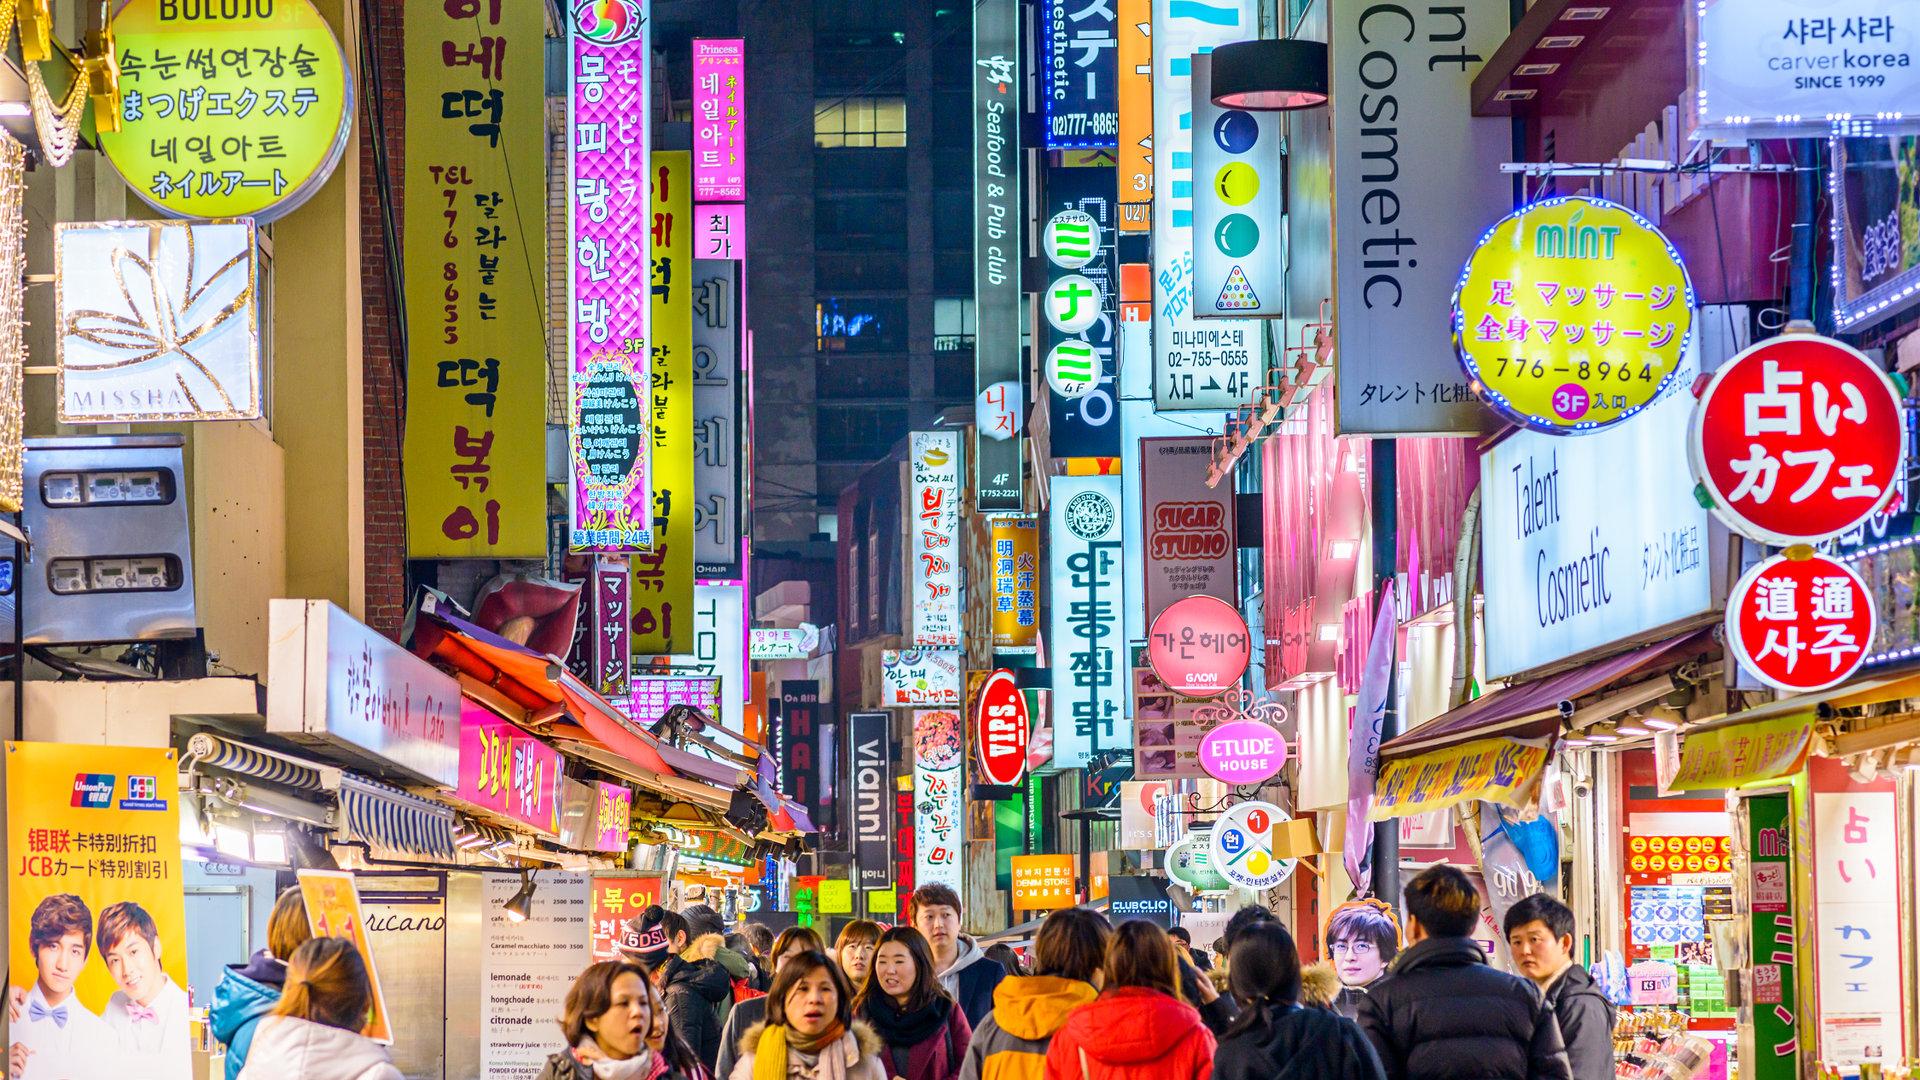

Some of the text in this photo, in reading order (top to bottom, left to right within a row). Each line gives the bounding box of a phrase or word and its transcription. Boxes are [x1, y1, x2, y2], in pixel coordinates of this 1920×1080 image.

[1783, 16, 1894, 45] 샤라 샤라
[120, 43, 320, 80] 속눈썹연장술
[700, 45, 738, 54] Princess
[1768, 49, 1910, 71] carver korea
[1795, 75, 1885, 89] SINCE 1999
[123, 87, 319, 121] まつげエクステ
[701, 73, 722, 167] 네일아트
[726, 76, 738, 165] ネイルアート
[150, 135, 287, 163] 네일아트
[987, 100, 1006, 178] Seafood
[1358, 4, 1417, 310] Cosmetic
[150, 170, 288, 198] ネイルアート
[429, 165, 473, 185] TEL
[577, 58, 612, 343] 몽피랑한방
[699, 188, 740, 196] 777-8562
[988, 184, 1005, 197] &
[988, 204, 1006, 239] Pub
[474, 191, 506, 320] 달라붙는
[988, 246, 1007, 285] club
[1489, 281, 1677, 310] 足 マッサージ
[1172, 331, 1244, 347] 미나미에스테
[1476, 314, 1676, 347] 全身マッサージ
[624, 338, 644, 354] 3F
[1168, 351, 1248, 368] 02-755-0555
[1497, 357, 1652, 383] 776-8964
[72, 388, 182, 411] MISSHA
[1065, 383, 1085, 393] 4F
[1169, 372, 1249, 400] 入口 4F
[1744, 360, 1868, 437] 占い
[986, 386, 1015, 440] 니지
[1555, 392, 1587, 412] 3F
[1592, 394, 1627, 409] 入口
[437, 358, 500, 545] 떡볶이
[992, 474, 1009, 485] 4F
[1729, 443, 1881, 504] カフェ
[987, 489, 1019, 497] 752-2221
[1513, 446, 1600, 540] Talent
[1158, 506, 1221, 528] SUGAR
[921, 486, 951, 600] 부대찌개
[1153, 533, 1224, 556] STUDIO
[997, 540, 1014, 613] 明洞瑞草
[1537, 526, 1612, 628] Cosmetic
[603, 577, 624, 683] マッサージ
[1066, 551, 1118, 737] 안동찜닭
[1154, 626, 1246, 660] 가온헤어
[1755, 624, 1860, 675] 사주
[1185, 672, 1217, 682] GAON
[424, 695, 445, 744] Cafe
[988, 705, 1017, 757] VIPS
[1211, 738, 1274, 757] ETUDE
[1219, 760, 1268, 771] HOUSE
[74, 780, 113, 793] UnionPay
[857, 739, 886, 841] vianni
[29, 827, 157, 854] 银联卡特别折扣
[1838, 805, 1877, 883] 占い
[19, 856, 168, 879] JCBカード特別割引
[1044, 878, 1070, 886] STORE
[1834, 925, 1873, 993] カフェ
[491, 973, 531, 981] lemonade
[491, 996, 535, 1005] hongchoade
[490, 1016, 533, 1025] citronade
